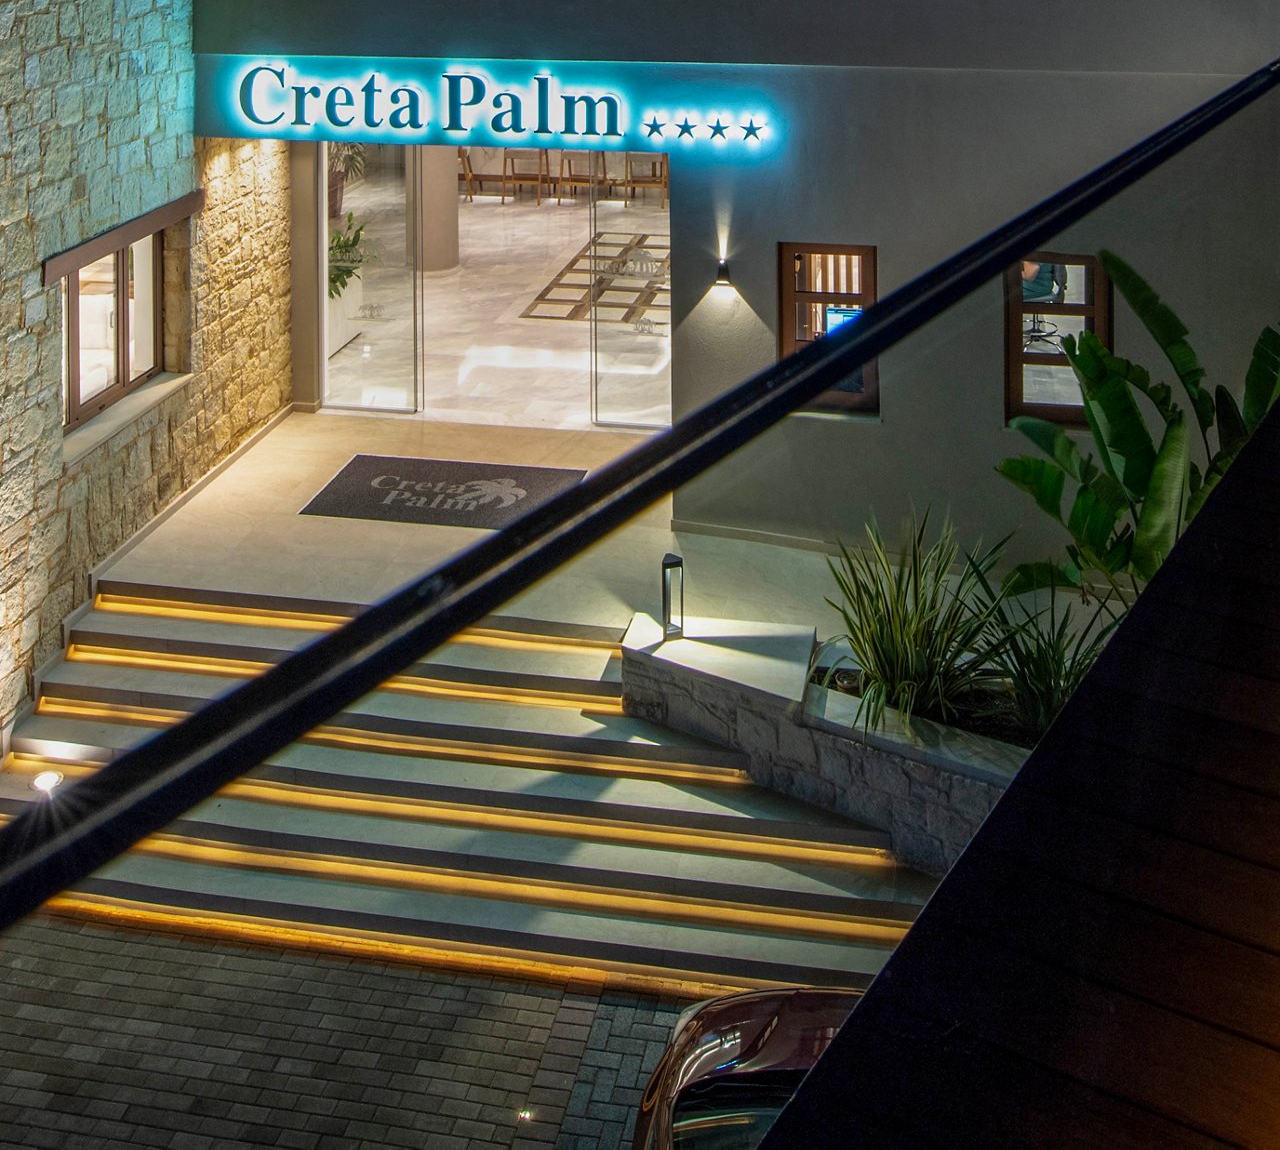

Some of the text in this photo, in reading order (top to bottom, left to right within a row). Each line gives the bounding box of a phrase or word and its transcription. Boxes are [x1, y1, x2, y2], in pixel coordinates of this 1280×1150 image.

[238, 65, 623, 137] Creta Palm
[371, 475, 466, 494] Creta
[381, 490, 478, 511] Palm
